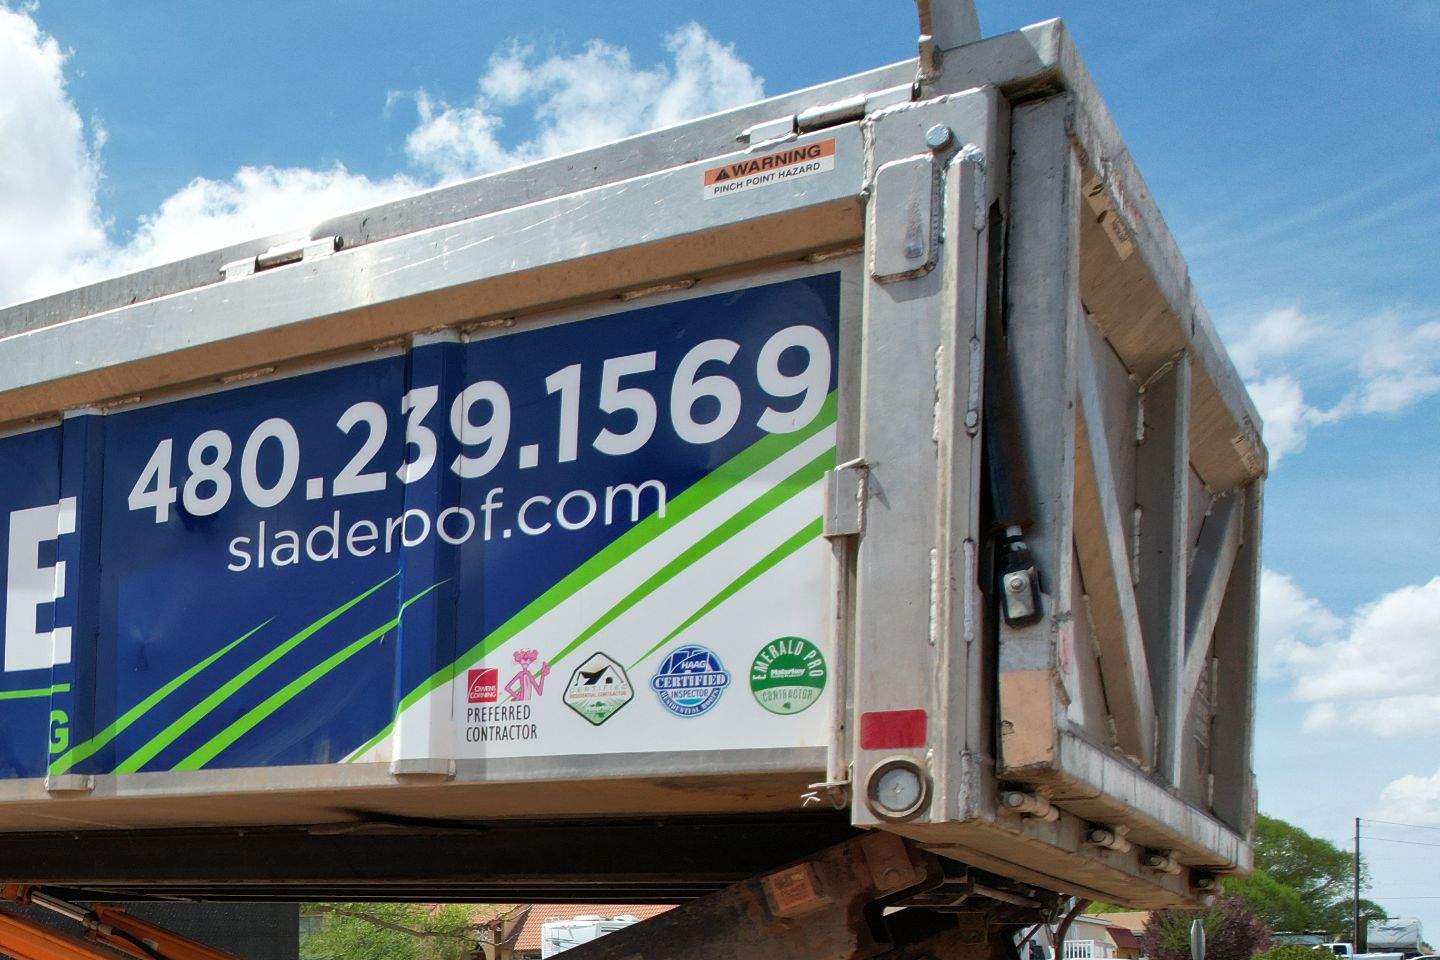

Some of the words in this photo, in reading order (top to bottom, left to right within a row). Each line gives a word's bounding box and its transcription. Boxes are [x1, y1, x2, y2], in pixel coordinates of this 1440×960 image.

[733, 144, 821, 177] WARNING
[714, 181, 743, 195] PINCH
[746, 173, 775, 188] POINT
[779, 162, 821, 179] HAZARD
[128, 324, 833, 523] 480.239.1569
[228, 479, 666, 572] sladeroof.com
[681, 660, 707, 669] HAAG
[752, 640, 804, 680] EMERALD
[803, 649, 824, 677] PRO
[655, 673, 726, 689] CERTIFIED
[470, 691, 497, 699] CORNING
[671, 689, 709, 698] INSPECTOR
[762, 689, 813, 702] CONTRACTOR
[467, 705, 531, 723] PREFERRED
[466, 724, 538, 742] CONTRACTOR
